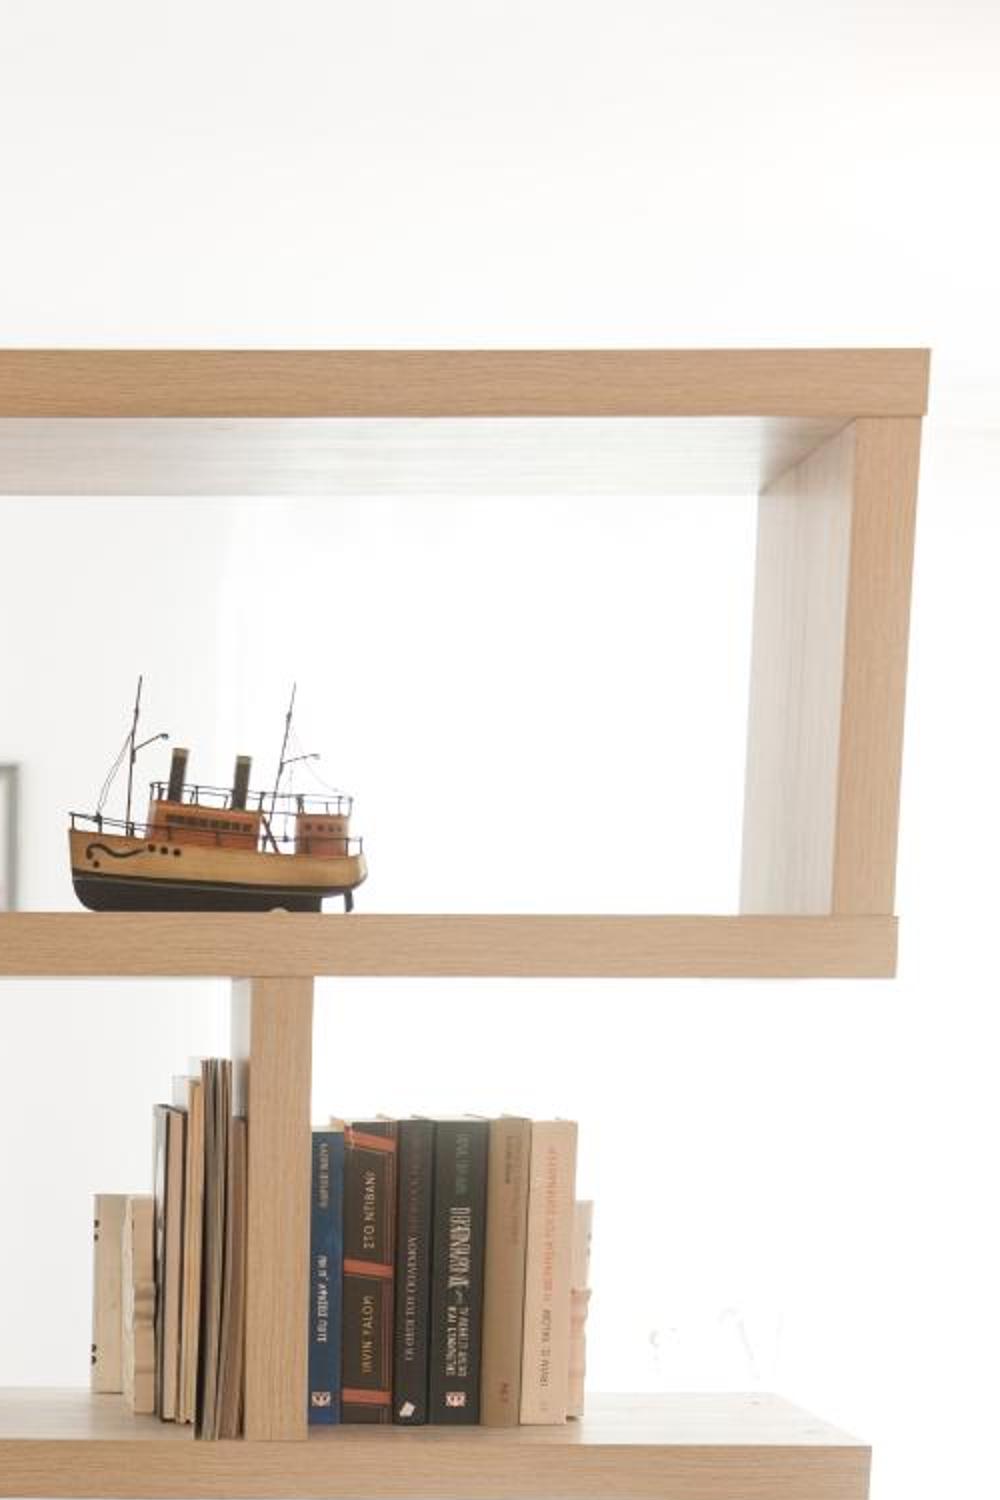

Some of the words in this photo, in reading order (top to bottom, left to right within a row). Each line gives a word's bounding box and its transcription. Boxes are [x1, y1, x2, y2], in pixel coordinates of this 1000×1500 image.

[362, 1169, 376, 1222] ΝΤΙΒΑΝΙ
[362, 1225, 375, 1249] ΣΤΟ
[361, 1295, 375, 1336] YALOM
[360, 1341, 373, 1373] IRVIN
